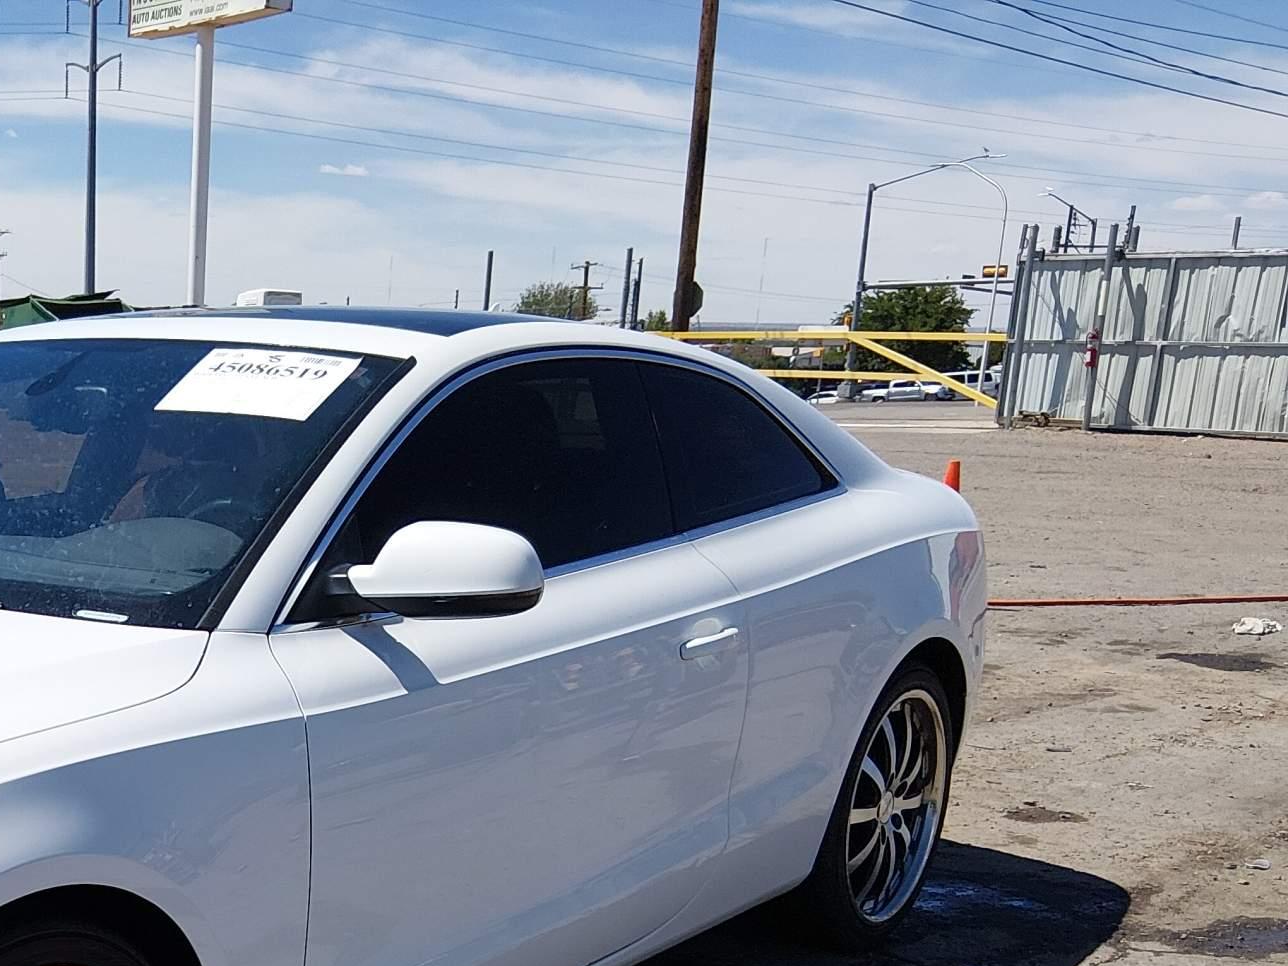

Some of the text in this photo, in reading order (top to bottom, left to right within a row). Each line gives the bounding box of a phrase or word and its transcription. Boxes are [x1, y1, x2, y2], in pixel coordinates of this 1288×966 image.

[132, 5, 182, 25] AUTO AUCTIONS
[209, 361, 328, 380] 45086519
